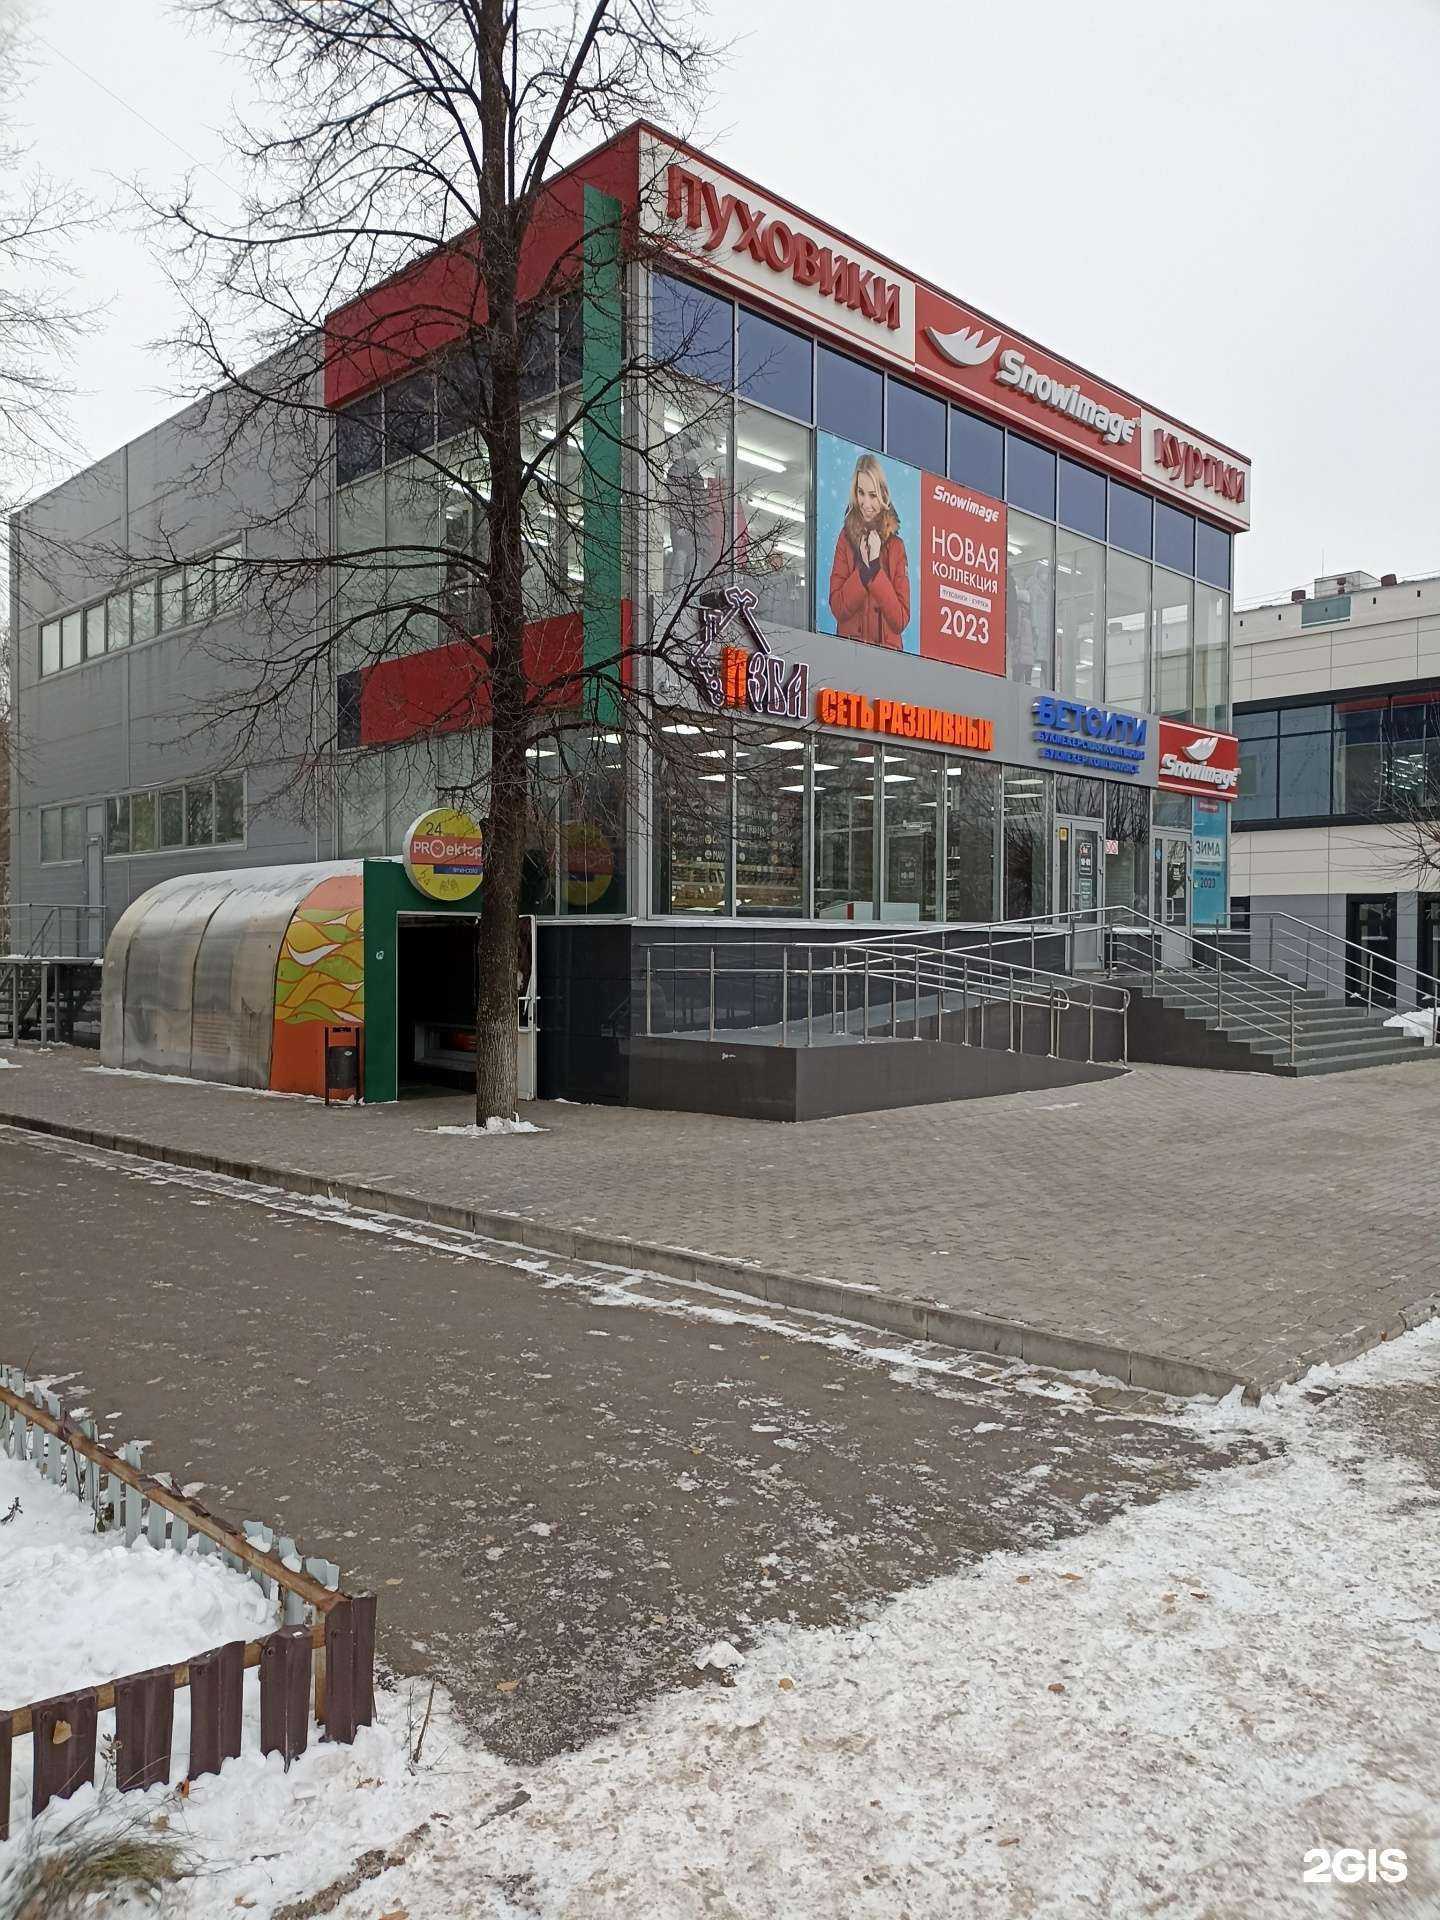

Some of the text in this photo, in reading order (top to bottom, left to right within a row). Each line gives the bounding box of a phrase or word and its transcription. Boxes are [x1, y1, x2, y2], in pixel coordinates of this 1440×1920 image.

[667, 165, 900, 330] ПУХОВИКИ
[995, 350, 1136, 444] Snowimage
[1154, 428, 1245, 503] КУРТКИ
[932, 485, 1000, 523] Snowimage
[931, 526, 999, 574] НОВАЯ
[932, 561, 998, 594] КОЛЛЕКЦИЯ
[940, 606, 989, 645] 2023
[817, 688, 995, 752] СЕТЬ РАЗЛИВНЫХ
[1033, 696, 1147, 746] БЕТСИТИ
[1159, 753, 1239, 790] Snowimage
[426, 822, 442, 835] 24
[1195, 840, 1221, 857] ЗИМА
